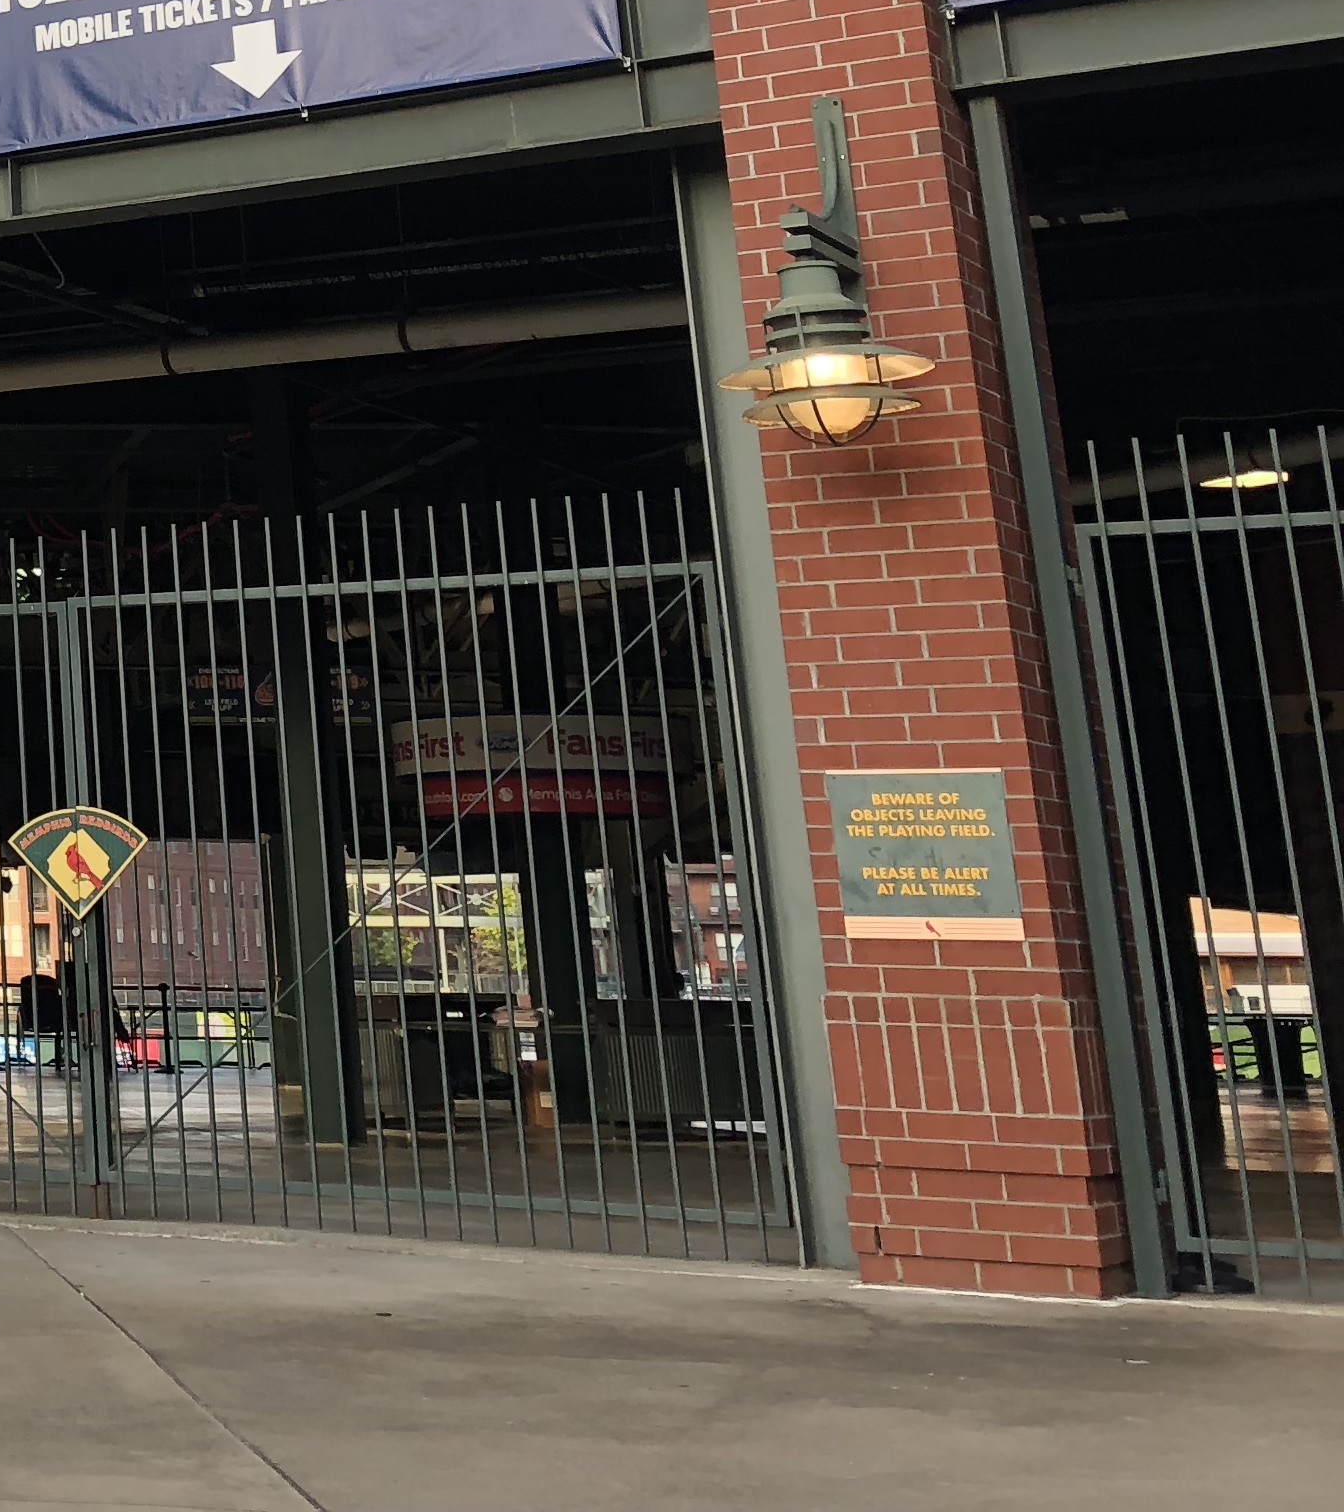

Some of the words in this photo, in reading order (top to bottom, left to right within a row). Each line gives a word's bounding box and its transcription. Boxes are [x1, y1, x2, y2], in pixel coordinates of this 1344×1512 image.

[33, 12, 134, 52] MOBILE
[871, 793, 934, 806] BEWARE
[938, 792, 960, 805] OF
[850, 809, 915, 821] OBJECTS
[919, 808, 987, 821] LEAVING
[846, 824, 874, 837] THE
[878, 824, 946, 837] PLAYING
[950, 824, 996, 837] FIELD.
[862, 867, 916, 880] PLEASE
[920, 867, 939, 880] BE
[944, 867, 990, 880] ALERT
[876, 883, 895, 896] AT
[900, 883, 927, 896] ALL
[932, 883, 982, 896] TIMES.
